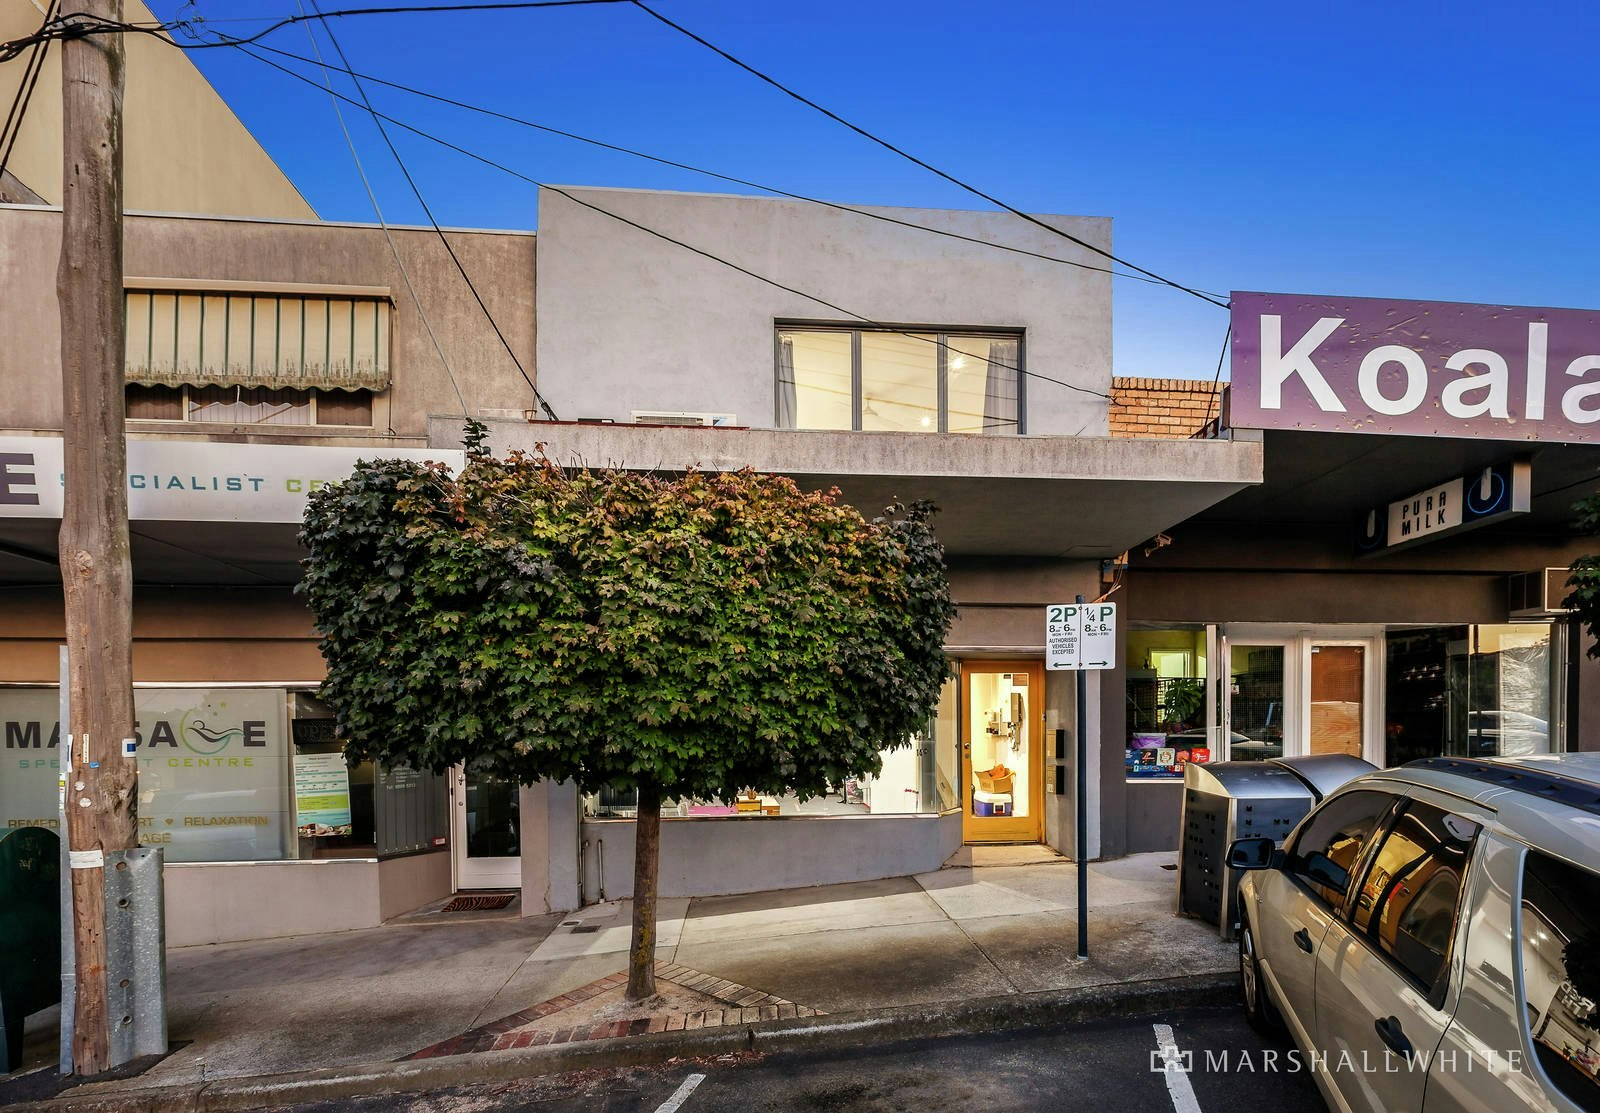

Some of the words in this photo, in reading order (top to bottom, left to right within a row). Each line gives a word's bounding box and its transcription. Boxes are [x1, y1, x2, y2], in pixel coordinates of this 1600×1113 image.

[1402, 509, 1446, 536] MILK
[1050, 607, 1077, 622] 2P
[168, 757, 255, 768] CENTRE
[184, 815, 270, 827] RELAXATION
